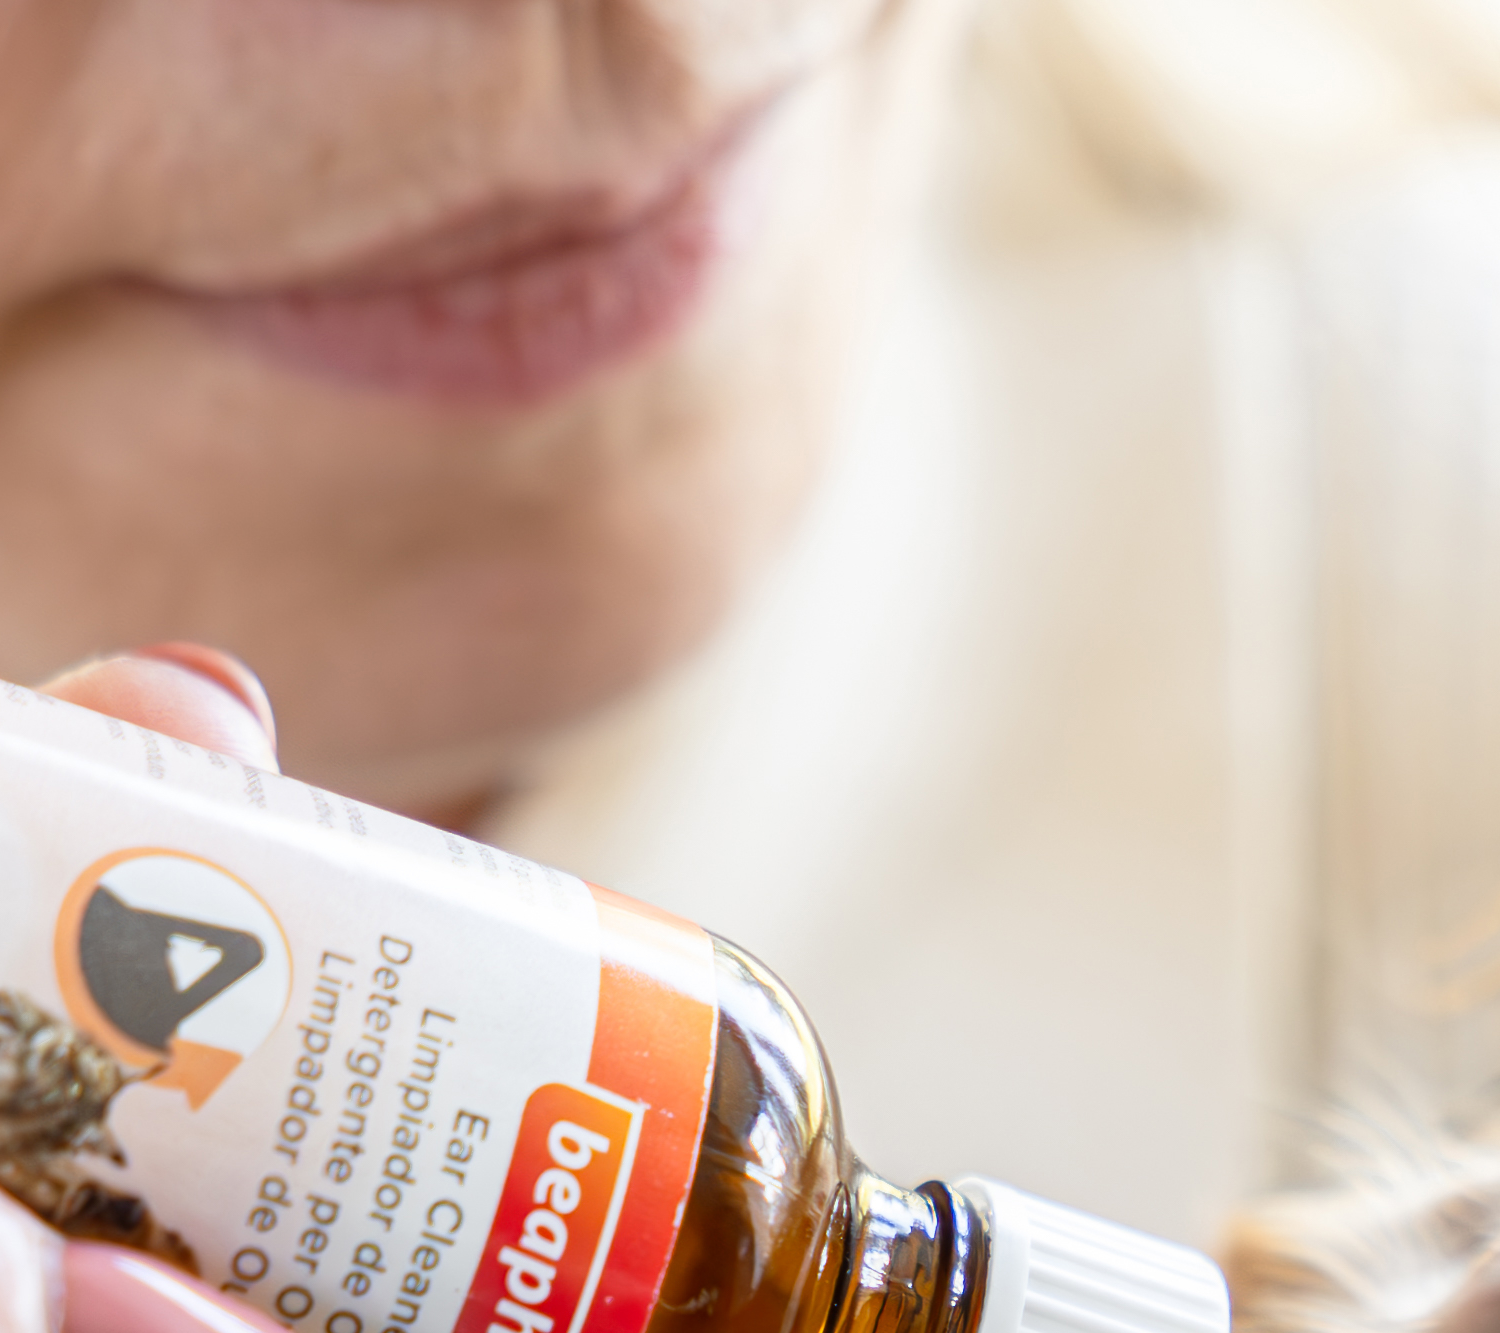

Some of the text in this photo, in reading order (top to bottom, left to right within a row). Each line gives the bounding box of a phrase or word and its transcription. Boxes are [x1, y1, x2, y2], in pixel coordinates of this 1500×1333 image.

[273, 950, 356, 1166] Limpador
[275, 934, 413, 1329] Detergente per O
[368, 1008, 457, 1232] Limpiador
[246, 1174, 293, 1232] de
[441, 1108, 489, 1186] Ear
[341, 1241, 387, 1297] de
